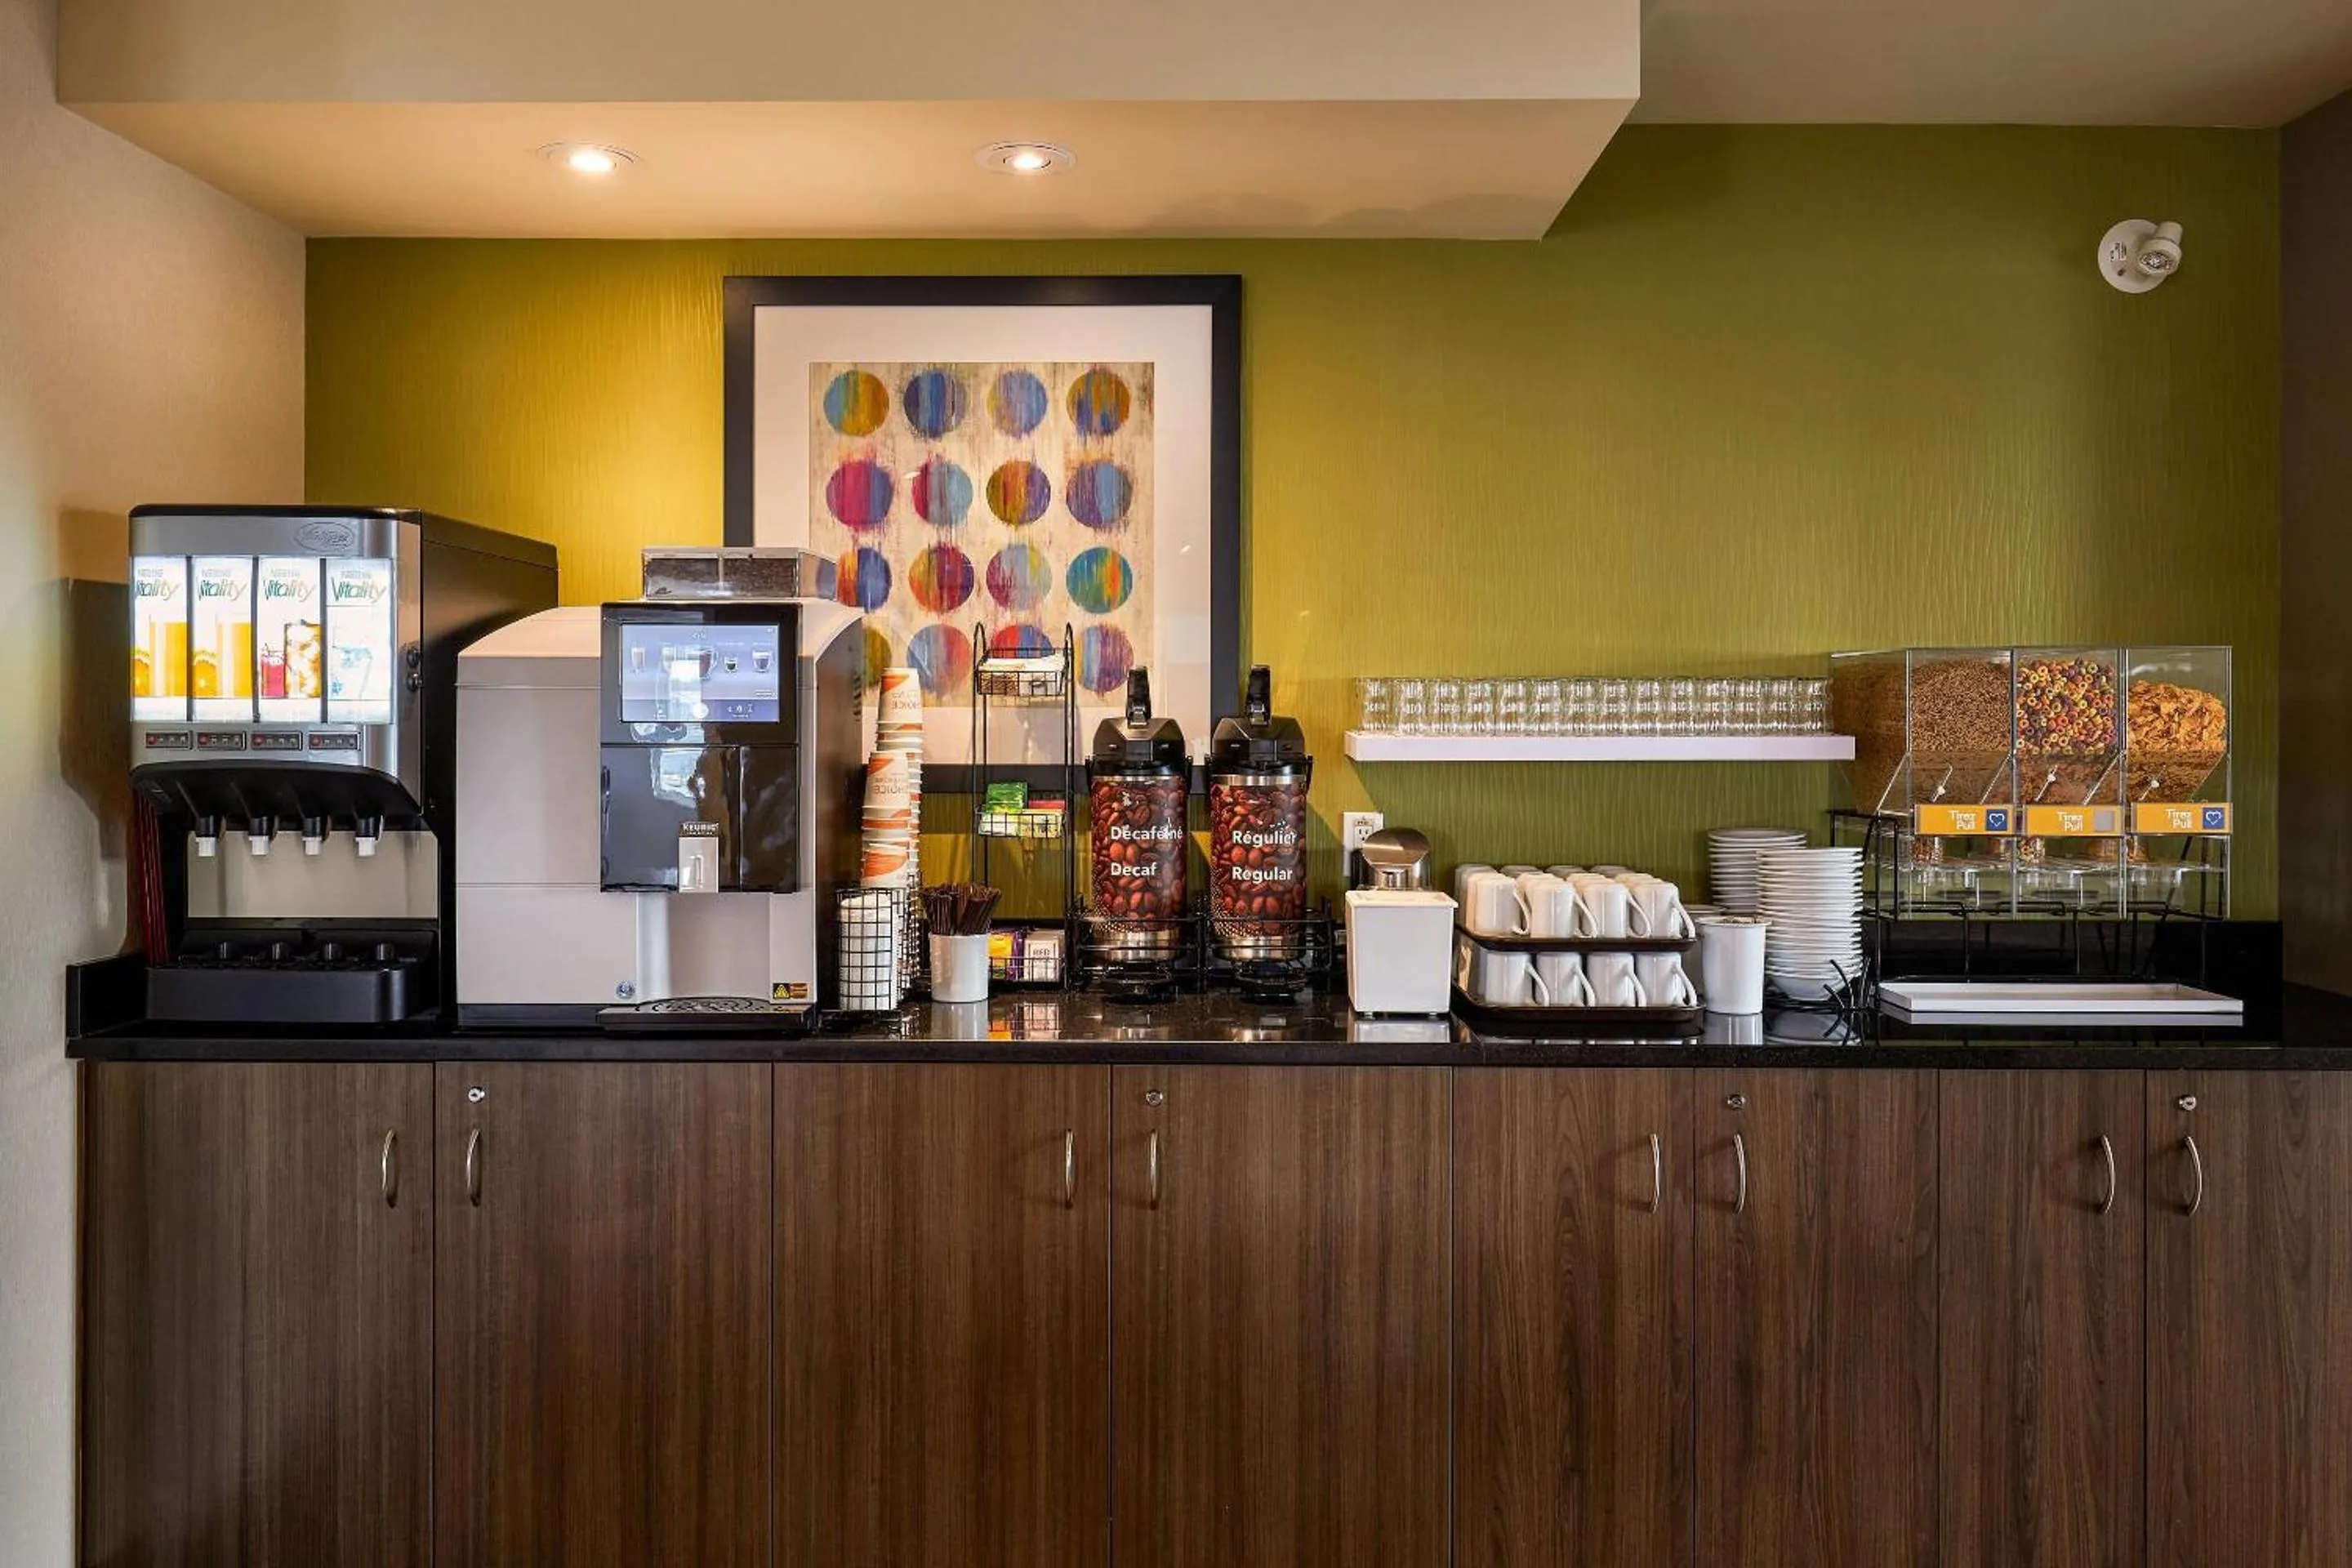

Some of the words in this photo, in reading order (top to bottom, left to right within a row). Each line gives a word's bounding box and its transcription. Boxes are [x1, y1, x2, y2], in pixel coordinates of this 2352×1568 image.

[331, 577, 386, 603] Vitality
[1956, 820, 1976, 831] Pull
[2064, 821, 2083, 831] Pull
[2173, 818, 2193, 829] Pull
[1232, 830, 1297, 848] Régulier
[1111, 862, 1157, 876] Decaf
[1232, 866, 1293, 884] Regular
